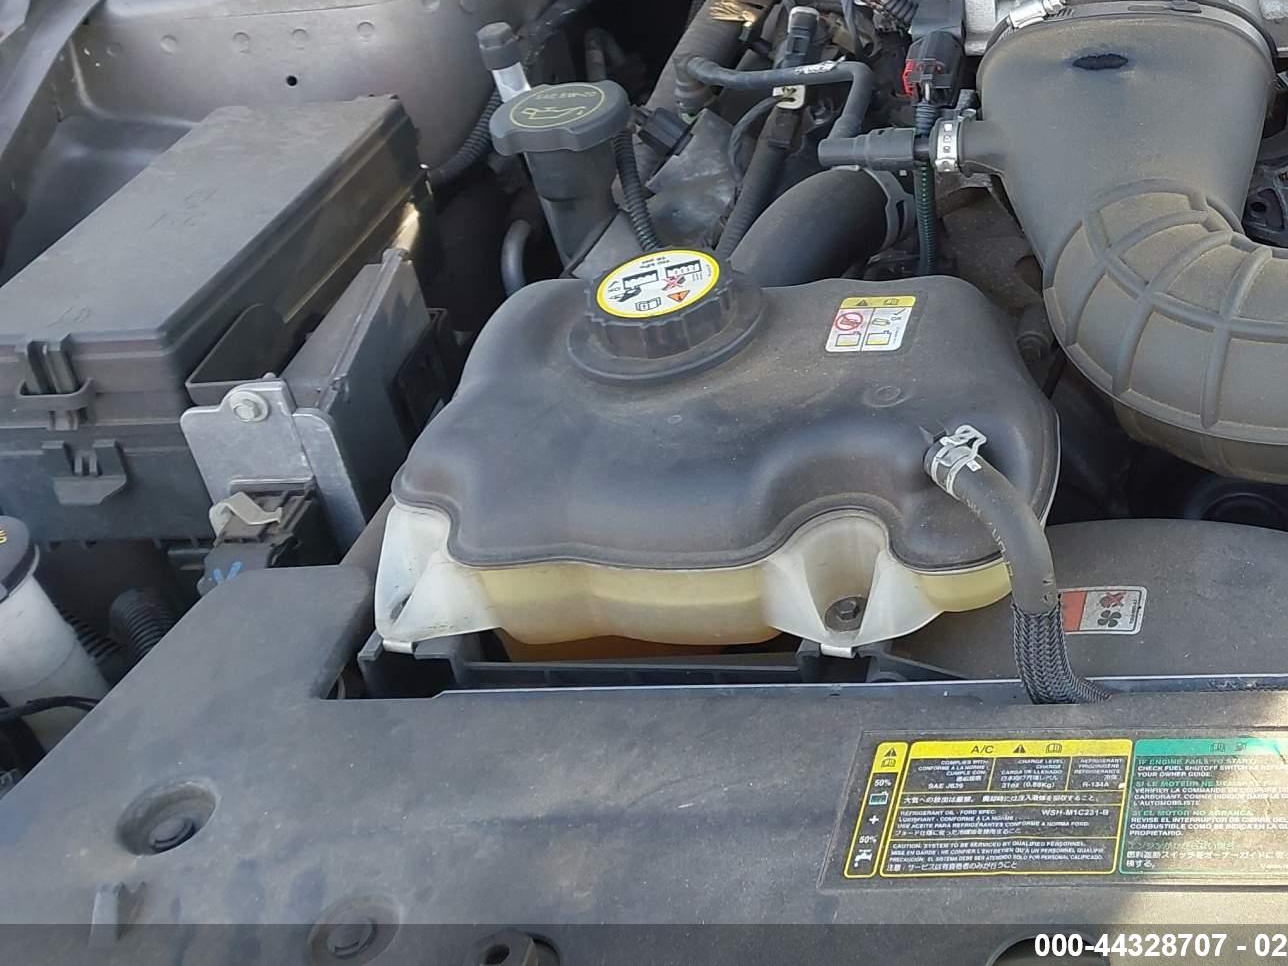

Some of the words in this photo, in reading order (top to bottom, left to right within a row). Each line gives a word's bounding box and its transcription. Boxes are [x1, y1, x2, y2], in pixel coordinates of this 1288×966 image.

[970, 745, 994, 754] A/C
[874, 778, 892, 787] 50%
[859, 836, 877, 844] 50%
